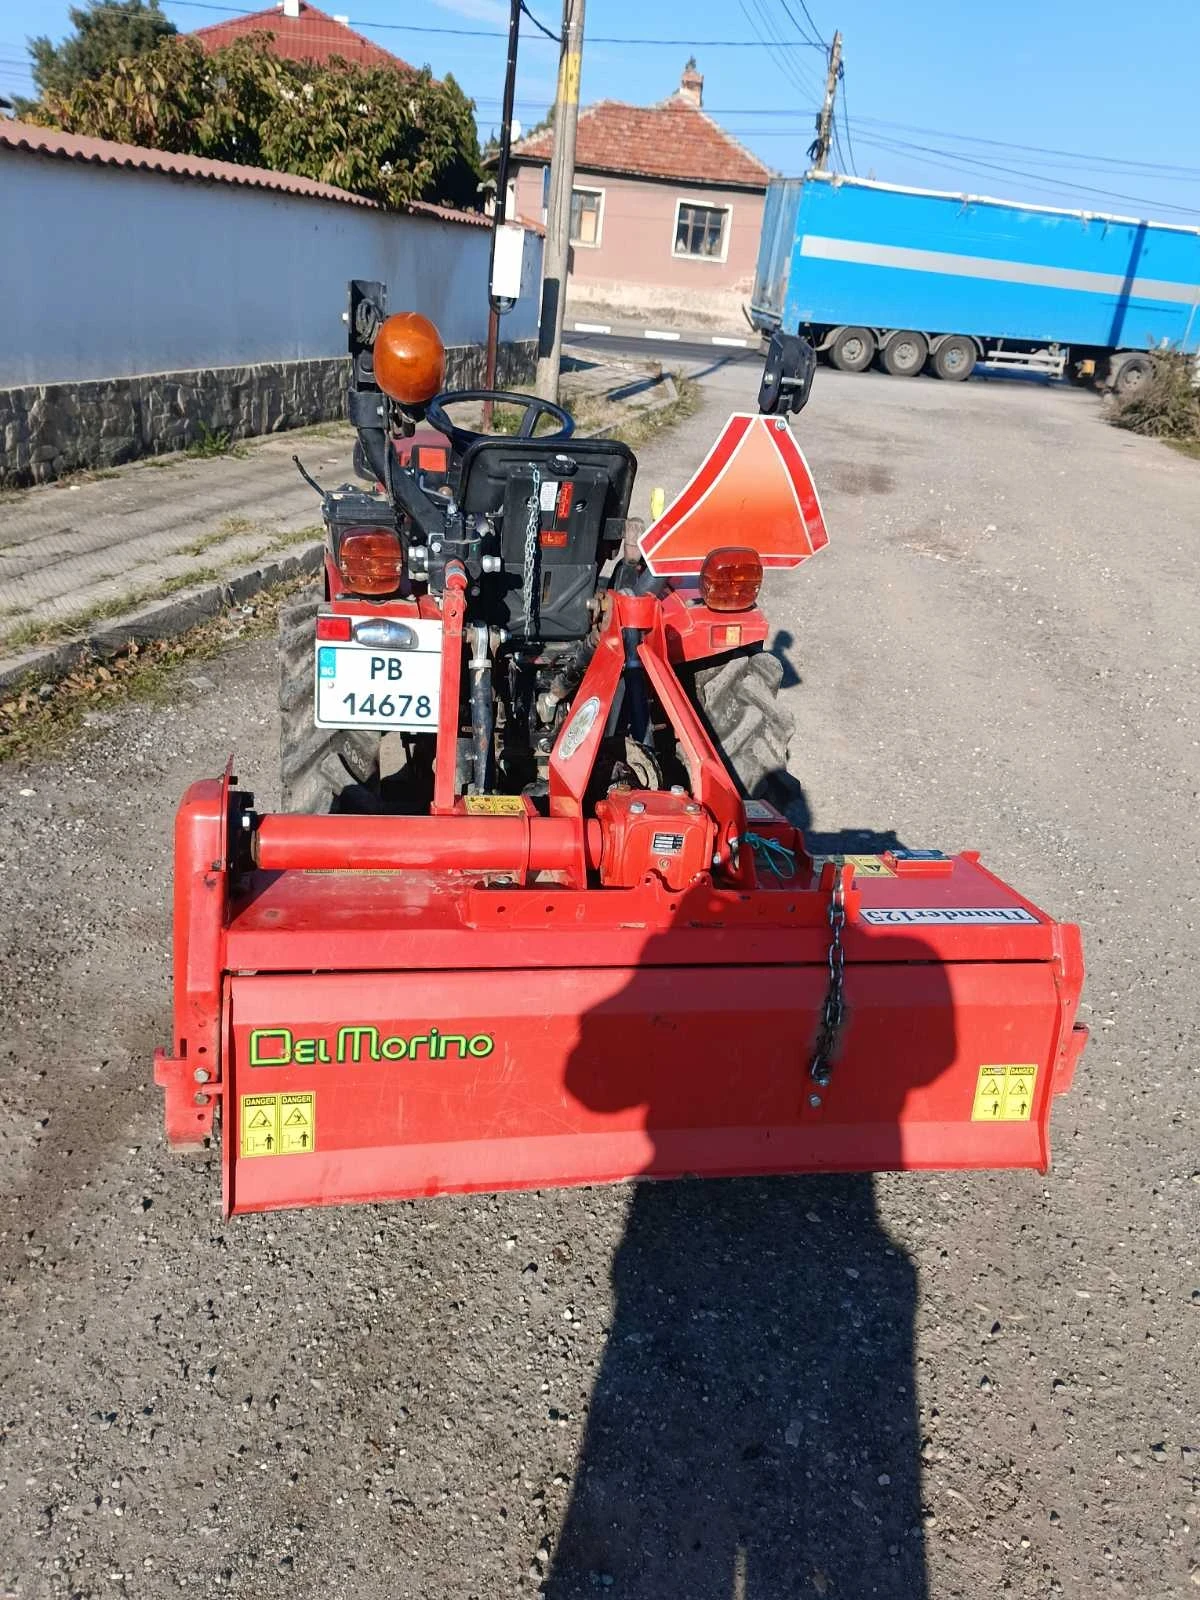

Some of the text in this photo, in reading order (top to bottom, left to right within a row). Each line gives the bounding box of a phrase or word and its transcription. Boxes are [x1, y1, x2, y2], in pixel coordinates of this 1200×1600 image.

[370, 656, 403, 681] PB
[342, 692, 432, 718] 14678
[245, 1097, 276, 1106] DANGER
[282, 1095, 312, 1104] DANGER
